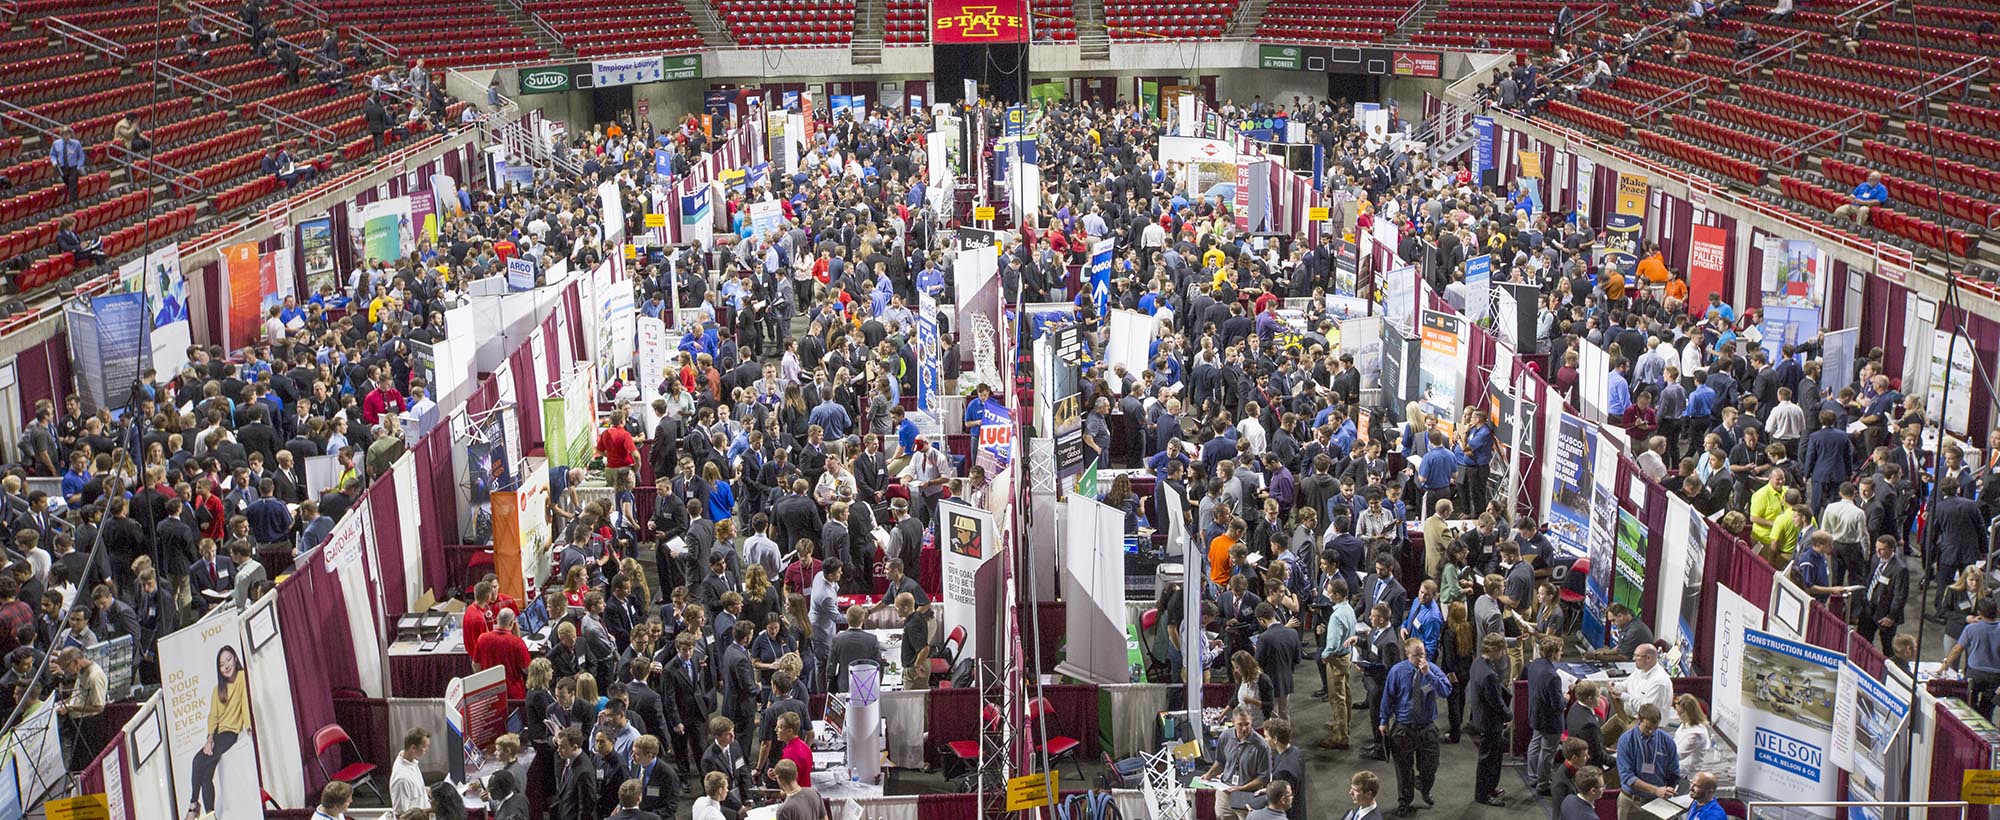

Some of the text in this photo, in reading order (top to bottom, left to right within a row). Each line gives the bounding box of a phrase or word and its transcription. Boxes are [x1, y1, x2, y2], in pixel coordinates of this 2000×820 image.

[938, 15, 1023, 28] STATE
[598, 60, 659, 72] Employer Lounge
[528, 73, 564, 87] Sukup
[1620, 176, 1646, 188] Make
[1620, 184, 1646, 194] Peace
[1694, 245, 1711, 254] MOVING
[1694, 250, 1724, 264] PALLETS
[510, 262, 531, 272] ARCO
[1692, 260, 1722, 272] EFFICIENTLY
[1557, 449, 1569, 459] GOOD
[1566, 444, 1583, 457] ELEVATE
[1556, 456, 1578, 472] MACHINES
[1562, 466, 1576, 477] GREAT
[948, 566, 973, 580] OUR GOAL
[1616, 558, 1644, 586] EFFICIENCY
[954, 576, 960, 585] TO
[948, 584, 960, 593] BEST
[201, 624, 222, 642] you
[1720, 610, 1731, 687] ebeam
[1746, 633, 1803, 656] CONSTRUCTION
[168, 670, 184, 683] DO
[170, 675, 199, 694] YOUR
[171, 688, 198, 707] BEST
[1873, 687, 1903, 715] CONTRACTOR
[173, 697, 206, 719] WORK
[175, 711, 205, 731] EVER.
[1755, 731, 1822, 767] NELSON
[1759, 752, 1773, 762] CARL
[1780, 759, 1801, 771] NELSON
[1807, 769, 1816, 777] CO.
